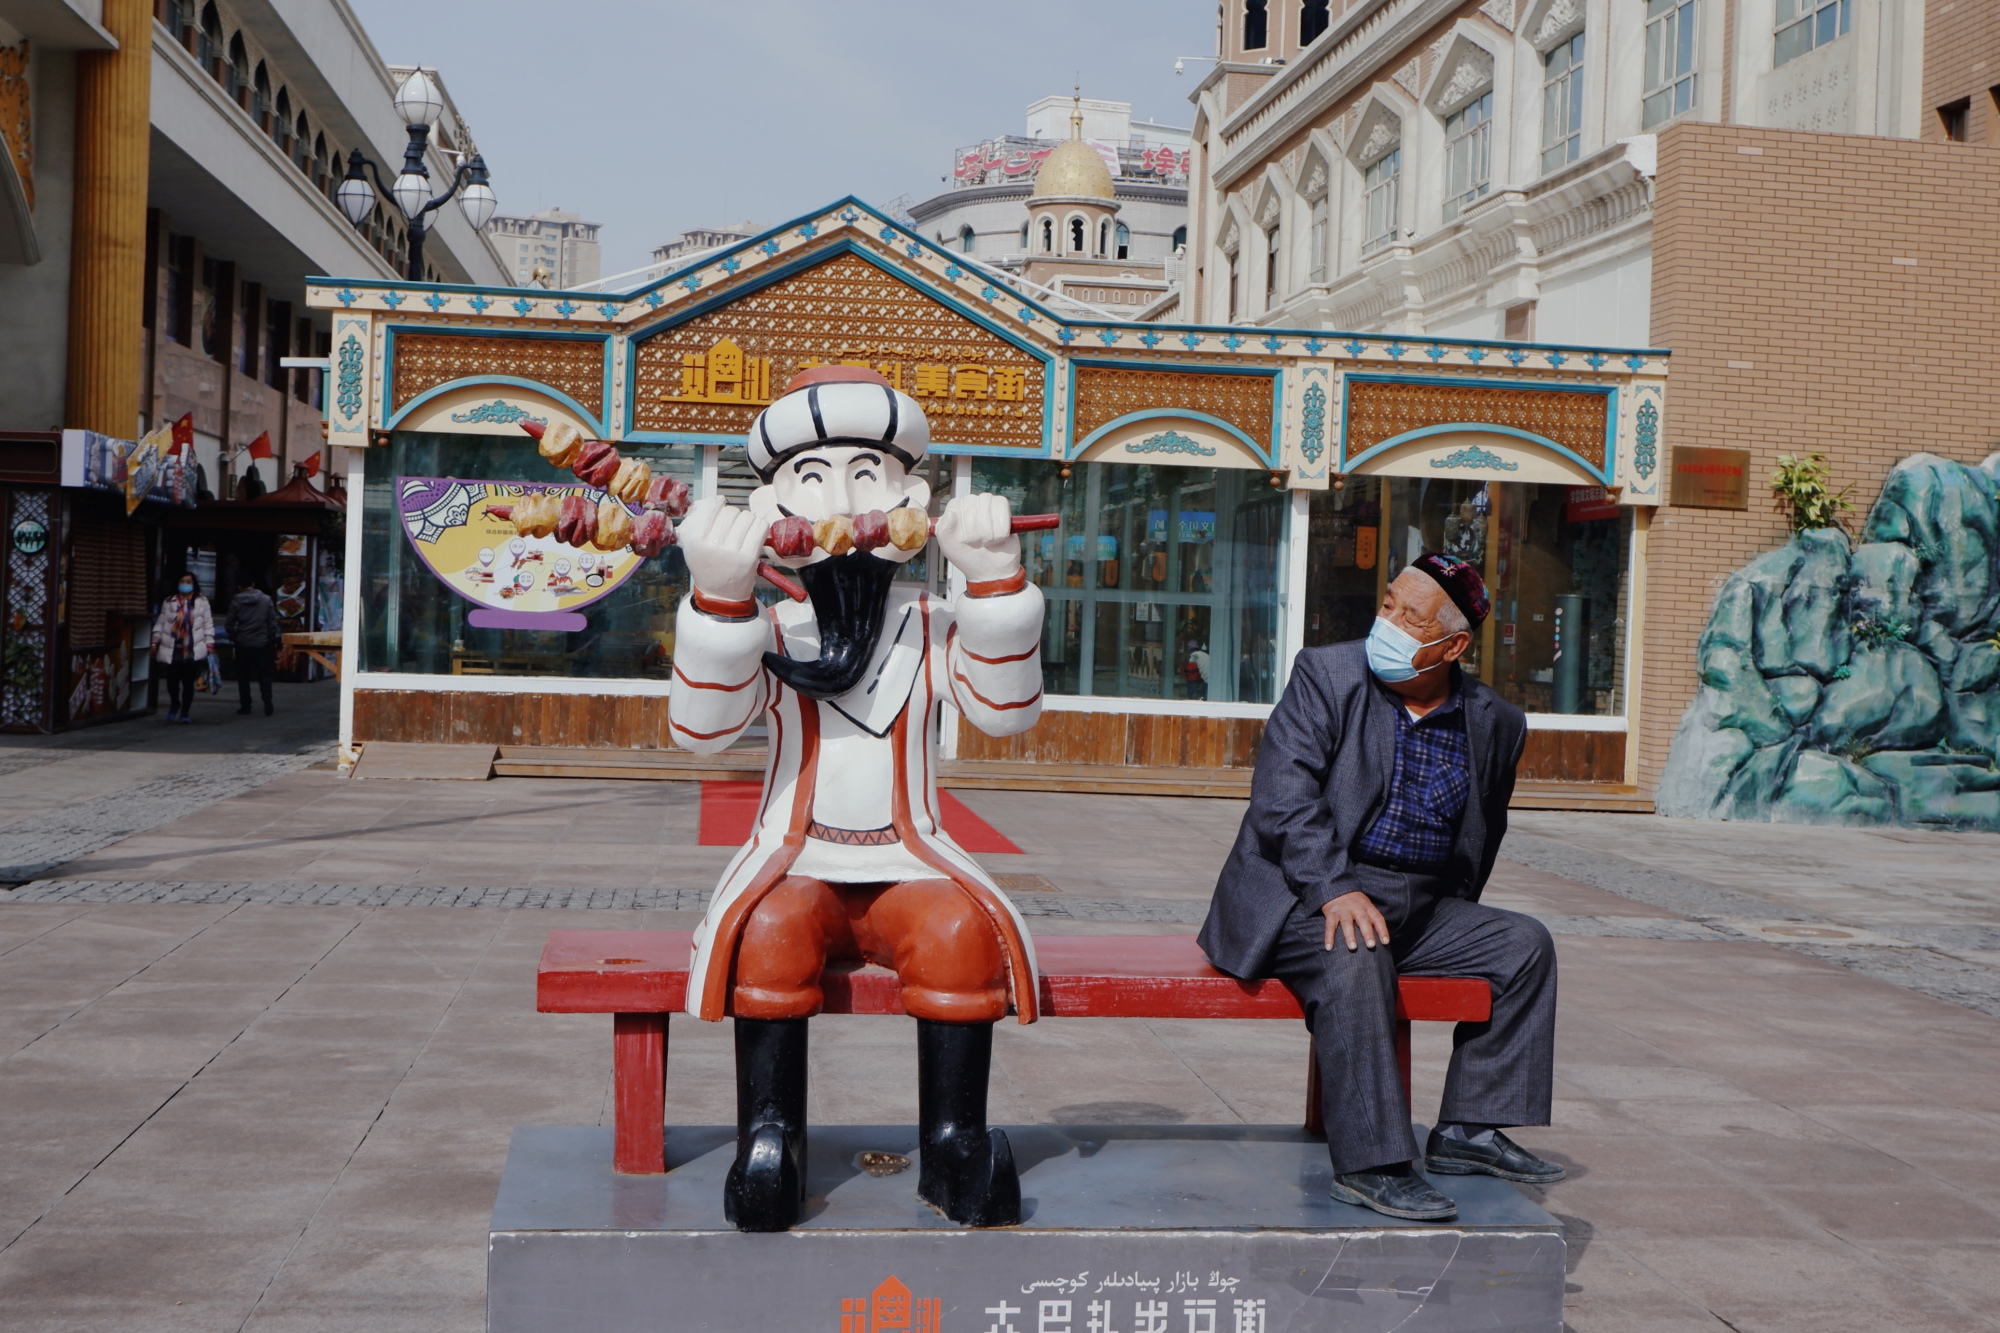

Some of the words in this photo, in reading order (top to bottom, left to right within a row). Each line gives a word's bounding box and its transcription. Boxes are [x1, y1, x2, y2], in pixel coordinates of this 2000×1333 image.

[799, 356, 1025, 401] 扎美食街
[958, 404, 1003, 416] Street
[1166, 1270, 1199, 1294] بازار
[1208, 1270, 1241, 1294] چوڭ
